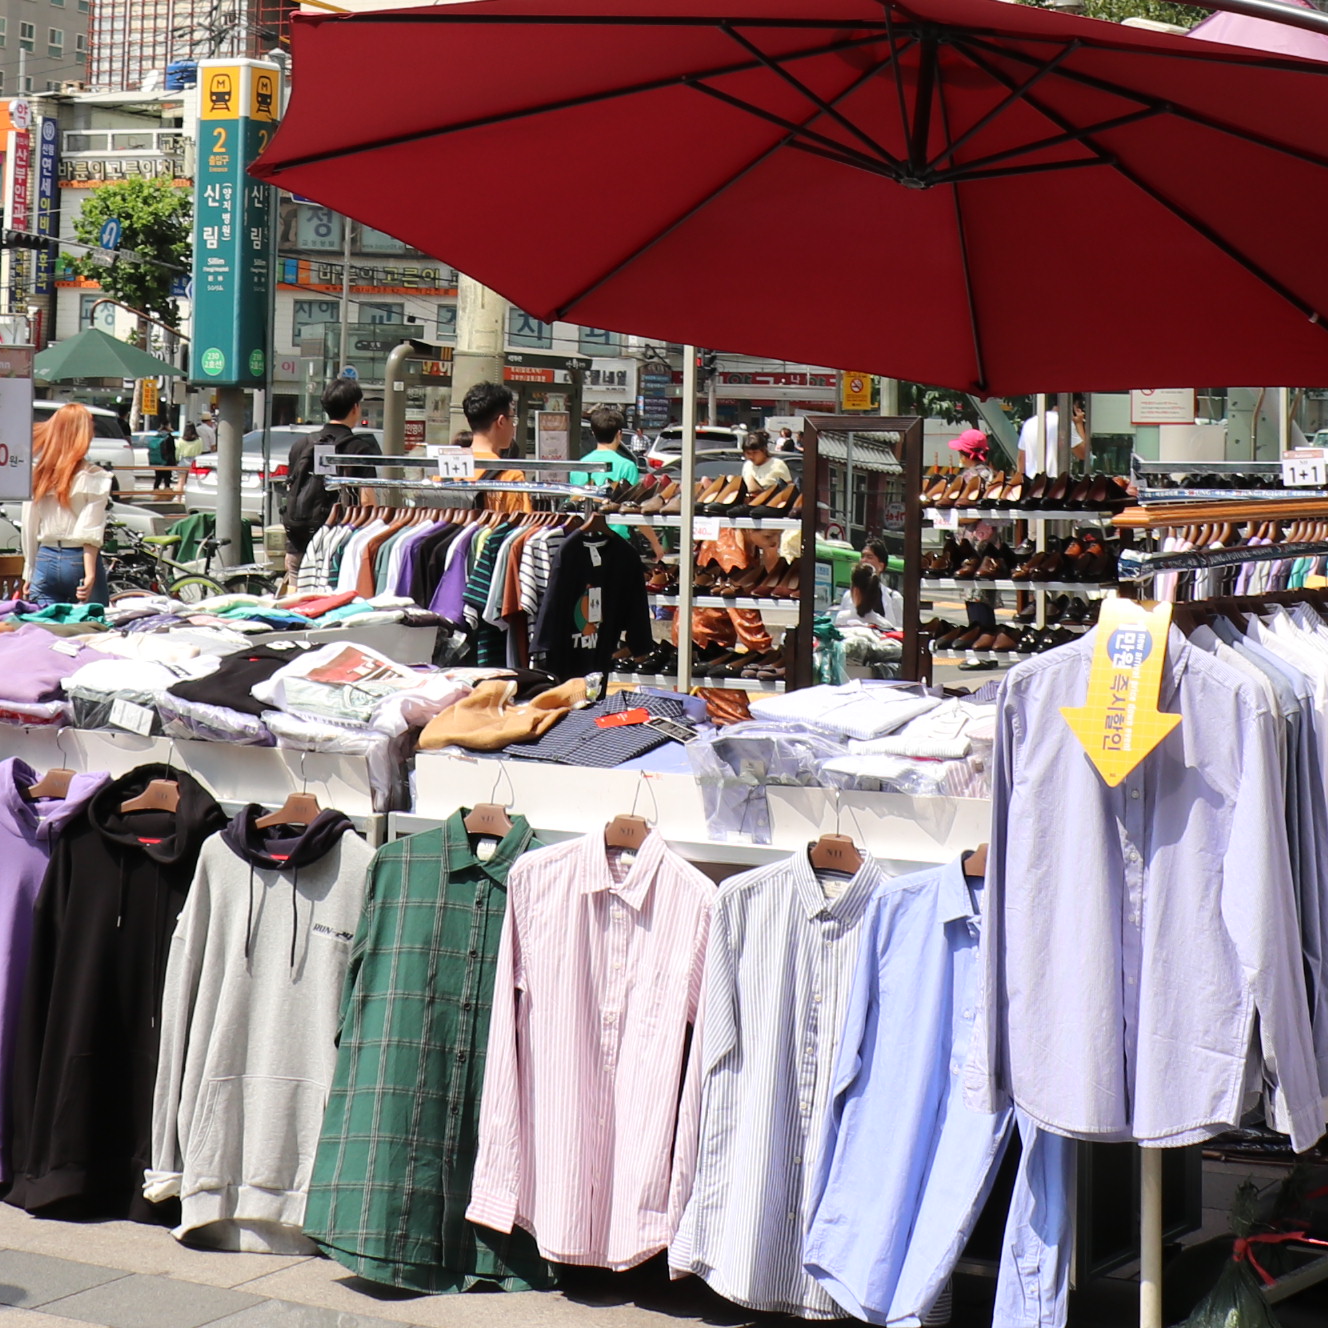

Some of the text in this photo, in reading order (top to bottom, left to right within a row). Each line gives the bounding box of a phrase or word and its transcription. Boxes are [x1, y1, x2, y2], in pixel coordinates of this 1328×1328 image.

[212, 127, 227, 153] 2
[208, 154, 230, 166] 출입구
[202, 182, 221, 250] 신림
[207, 351, 219, 361] 230
[443, 461, 470, 477] 1+1
[1289, 465, 1318, 484] 1+1
[1102, 673, 1130, 751] 즉시할인
